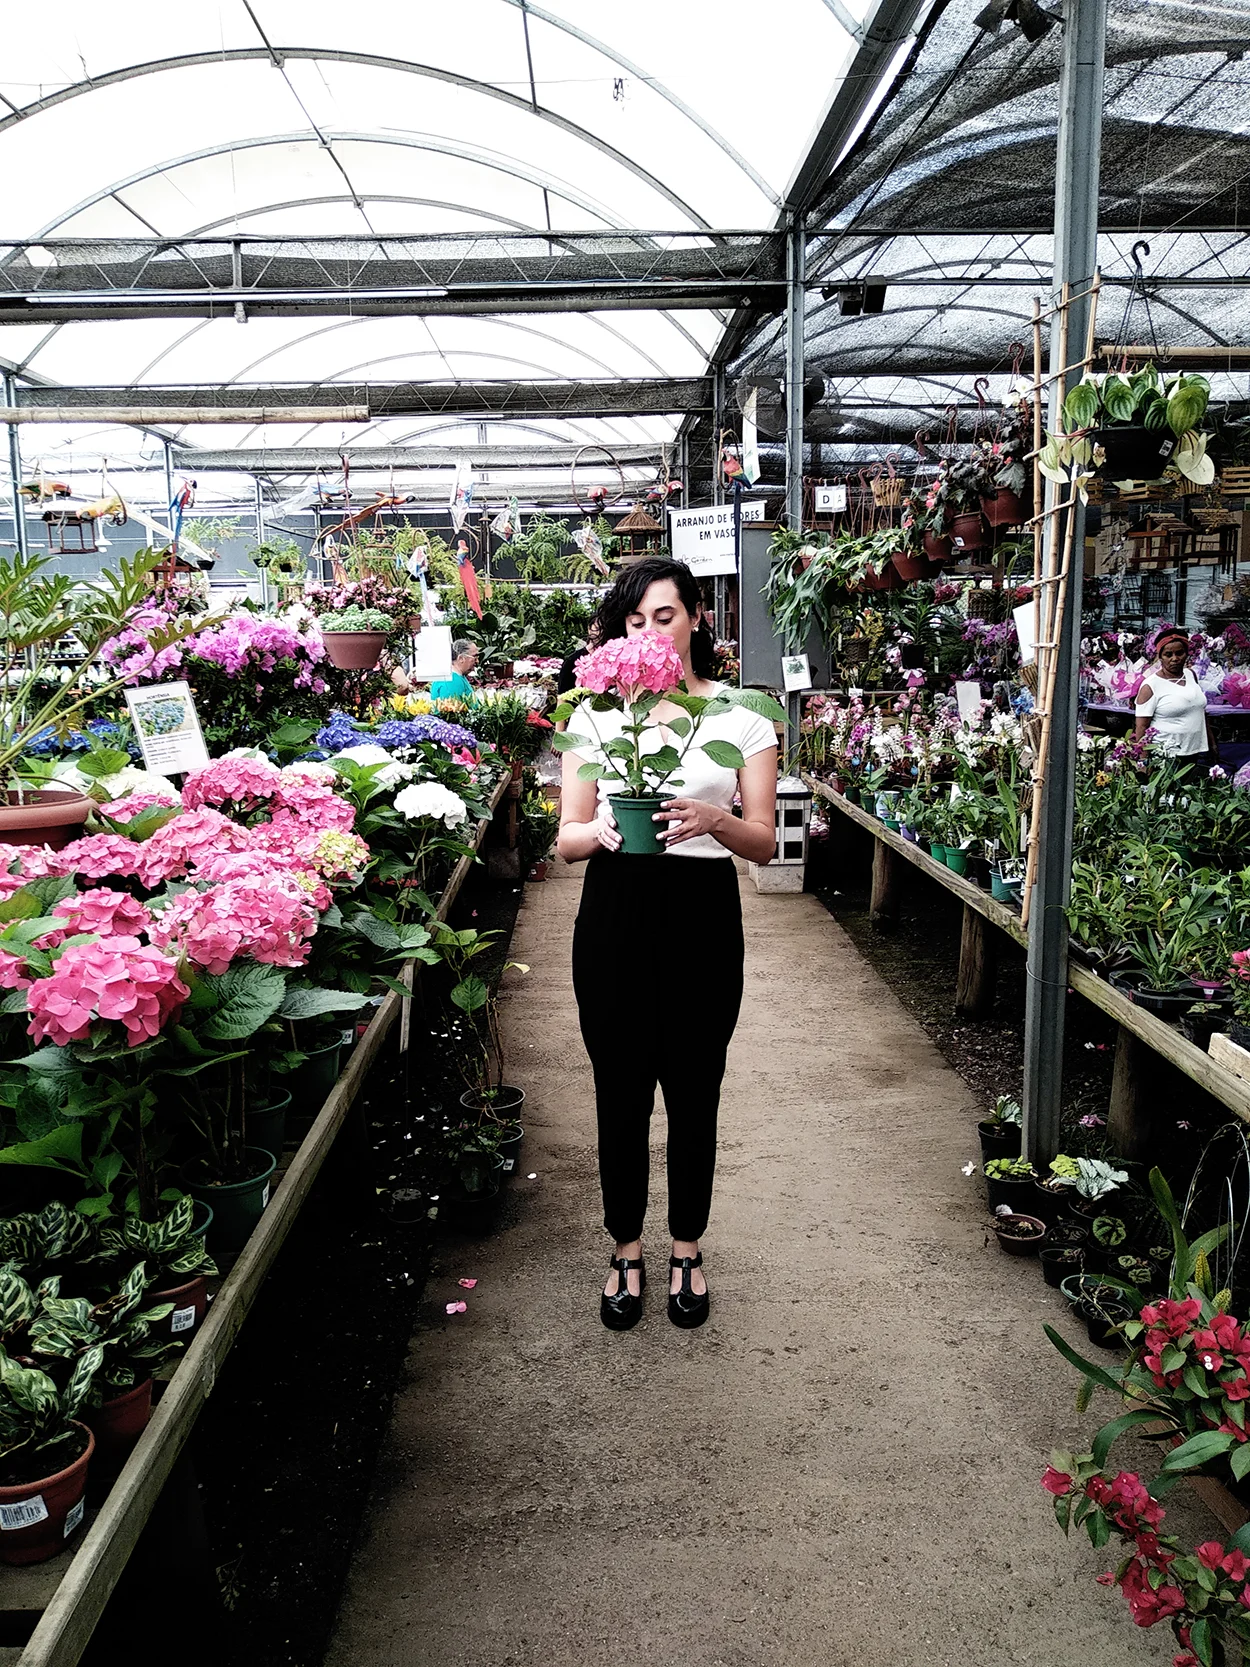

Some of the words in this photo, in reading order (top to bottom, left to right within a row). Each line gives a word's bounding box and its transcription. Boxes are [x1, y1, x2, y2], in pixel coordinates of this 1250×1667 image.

[822, 495, 830, 504] D
[676, 515, 714, 528] ARRANJO
[717, 513, 727, 524] DE
[730, 510, 759, 522] FORES
[699, 530, 711, 540] EM
